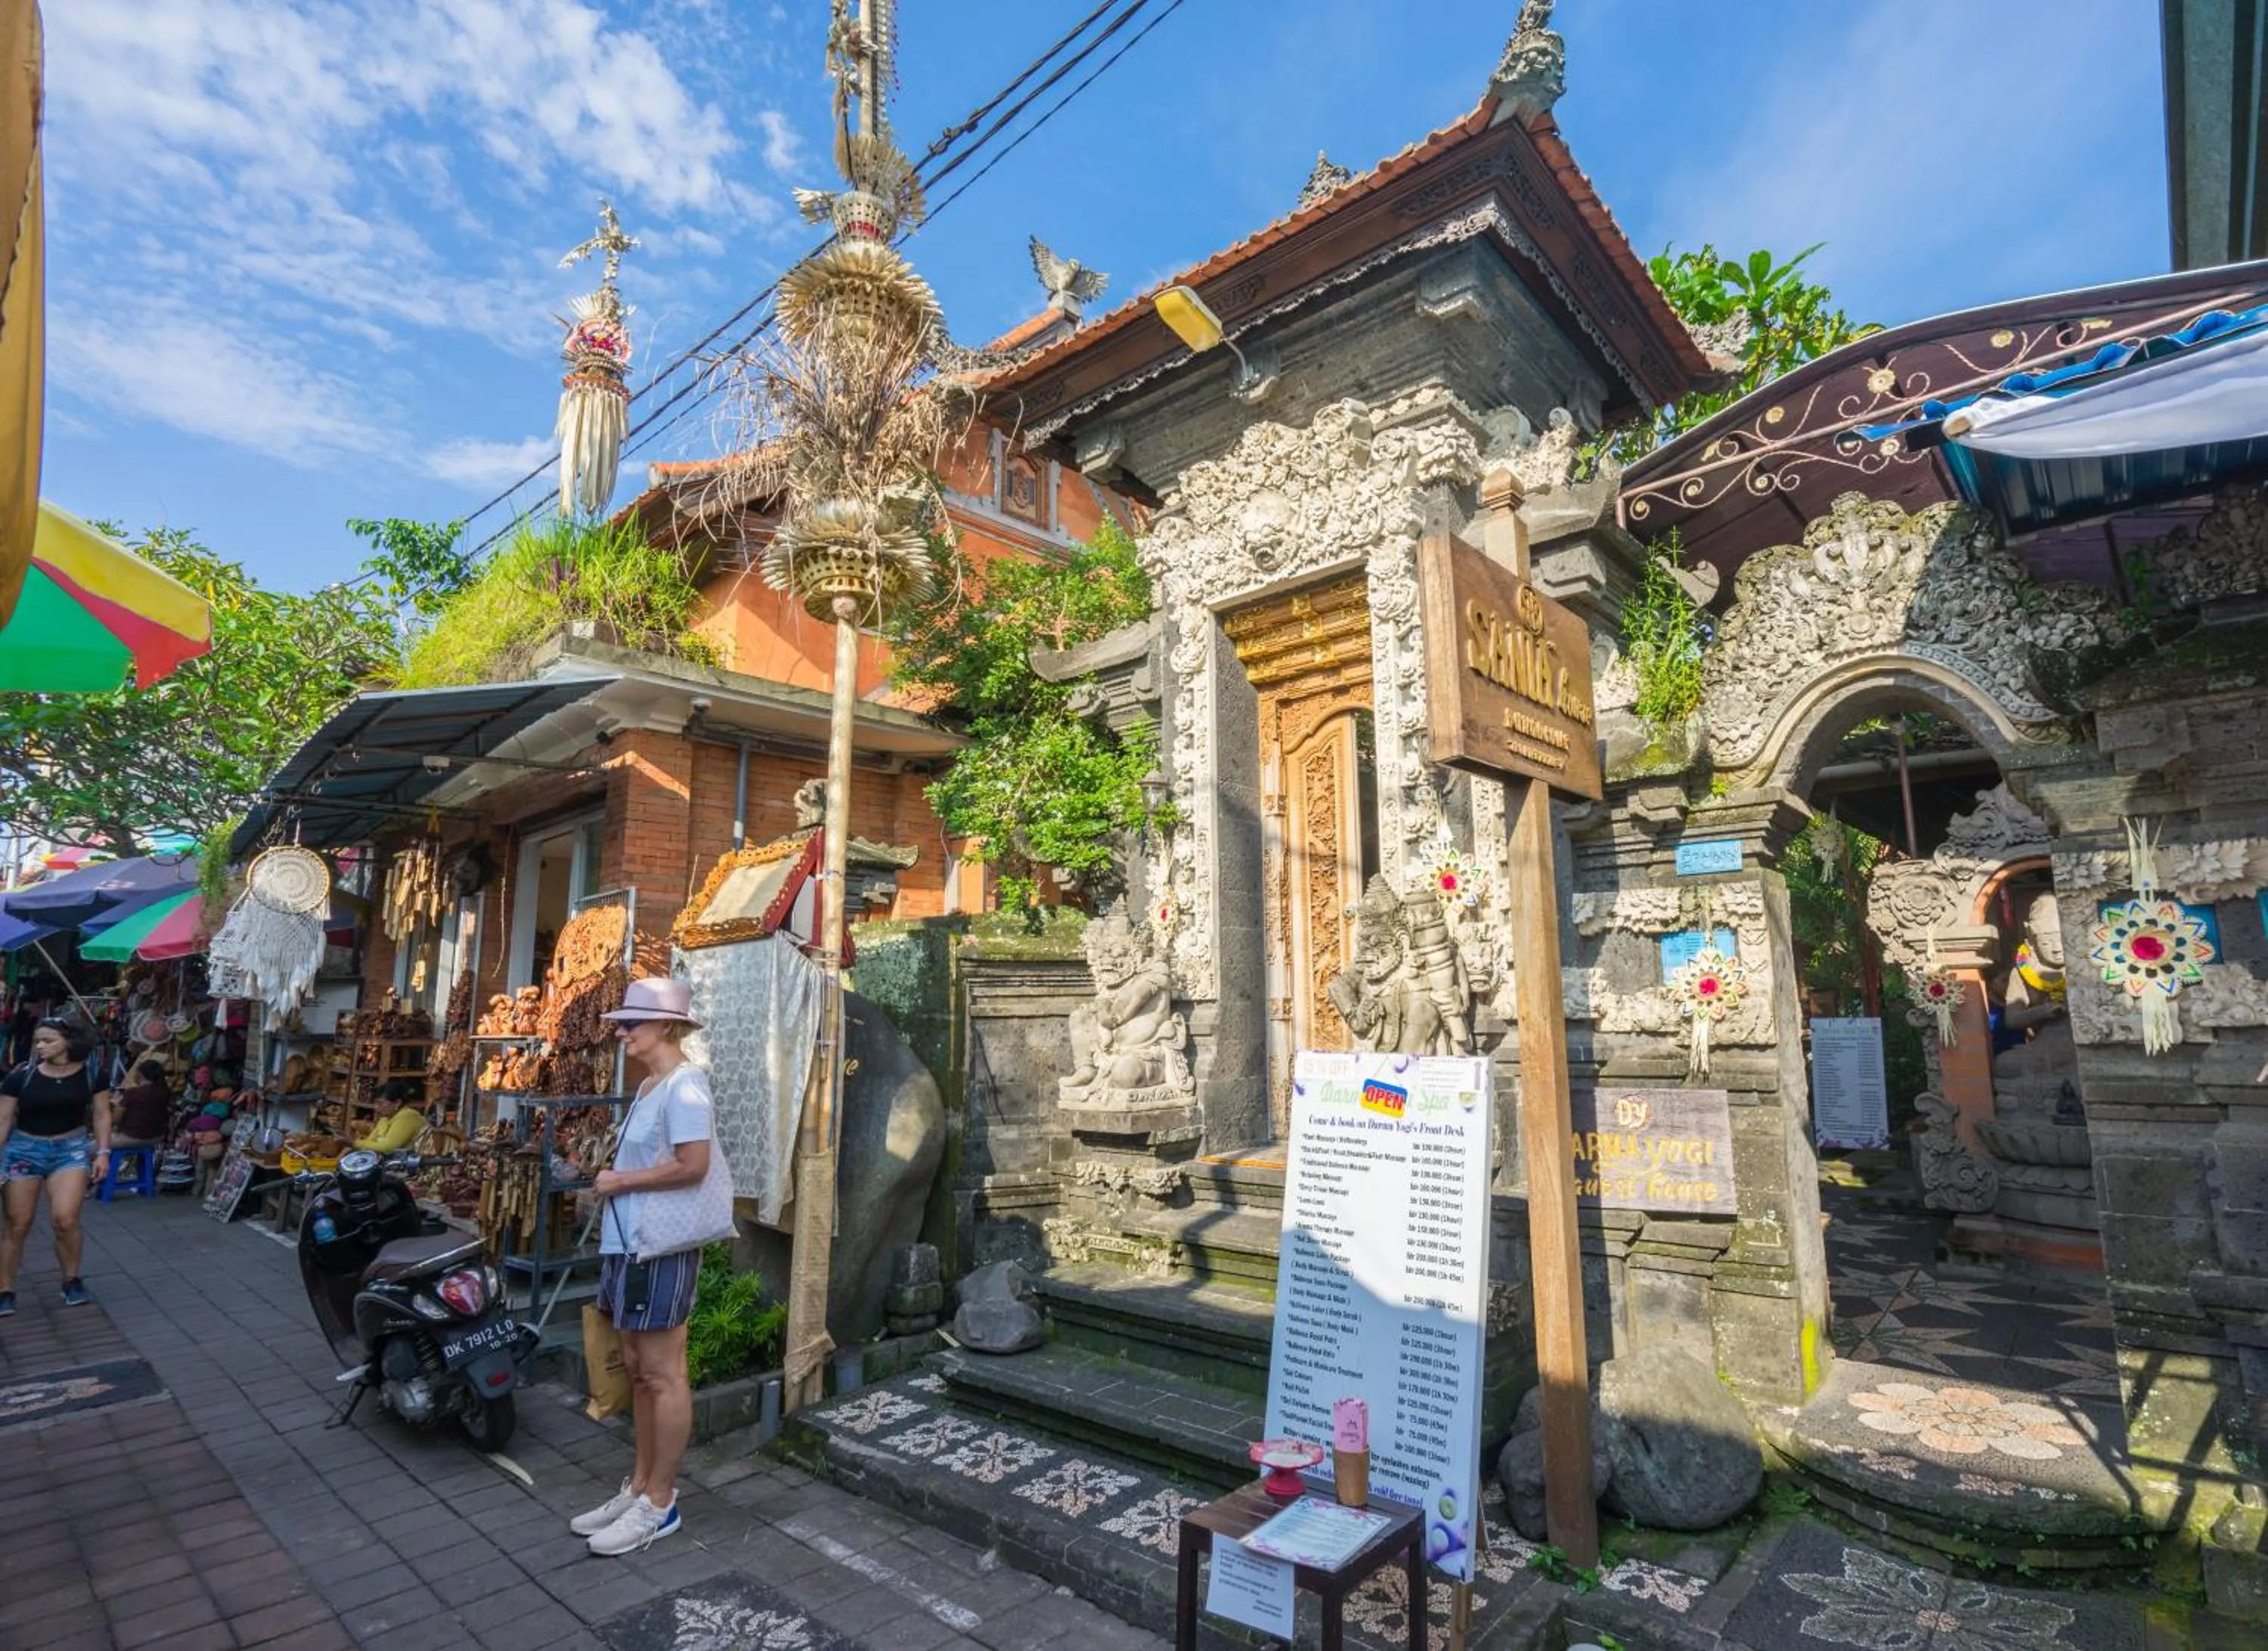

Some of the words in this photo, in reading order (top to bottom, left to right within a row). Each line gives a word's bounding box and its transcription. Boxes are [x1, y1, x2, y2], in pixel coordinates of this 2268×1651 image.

[1365, 1086, 1405, 1110] OPEN
[1419, 1122, 1442, 1135] Front
[1444, 1123, 1465, 1137] Desk
[1572, 1132, 1641, 1162] ARMA
[1644, 1135, 1715, 1169] YOGI
[444, 1341, 465, 1358] DK
[466, 1326, 494, 1349] 7912
